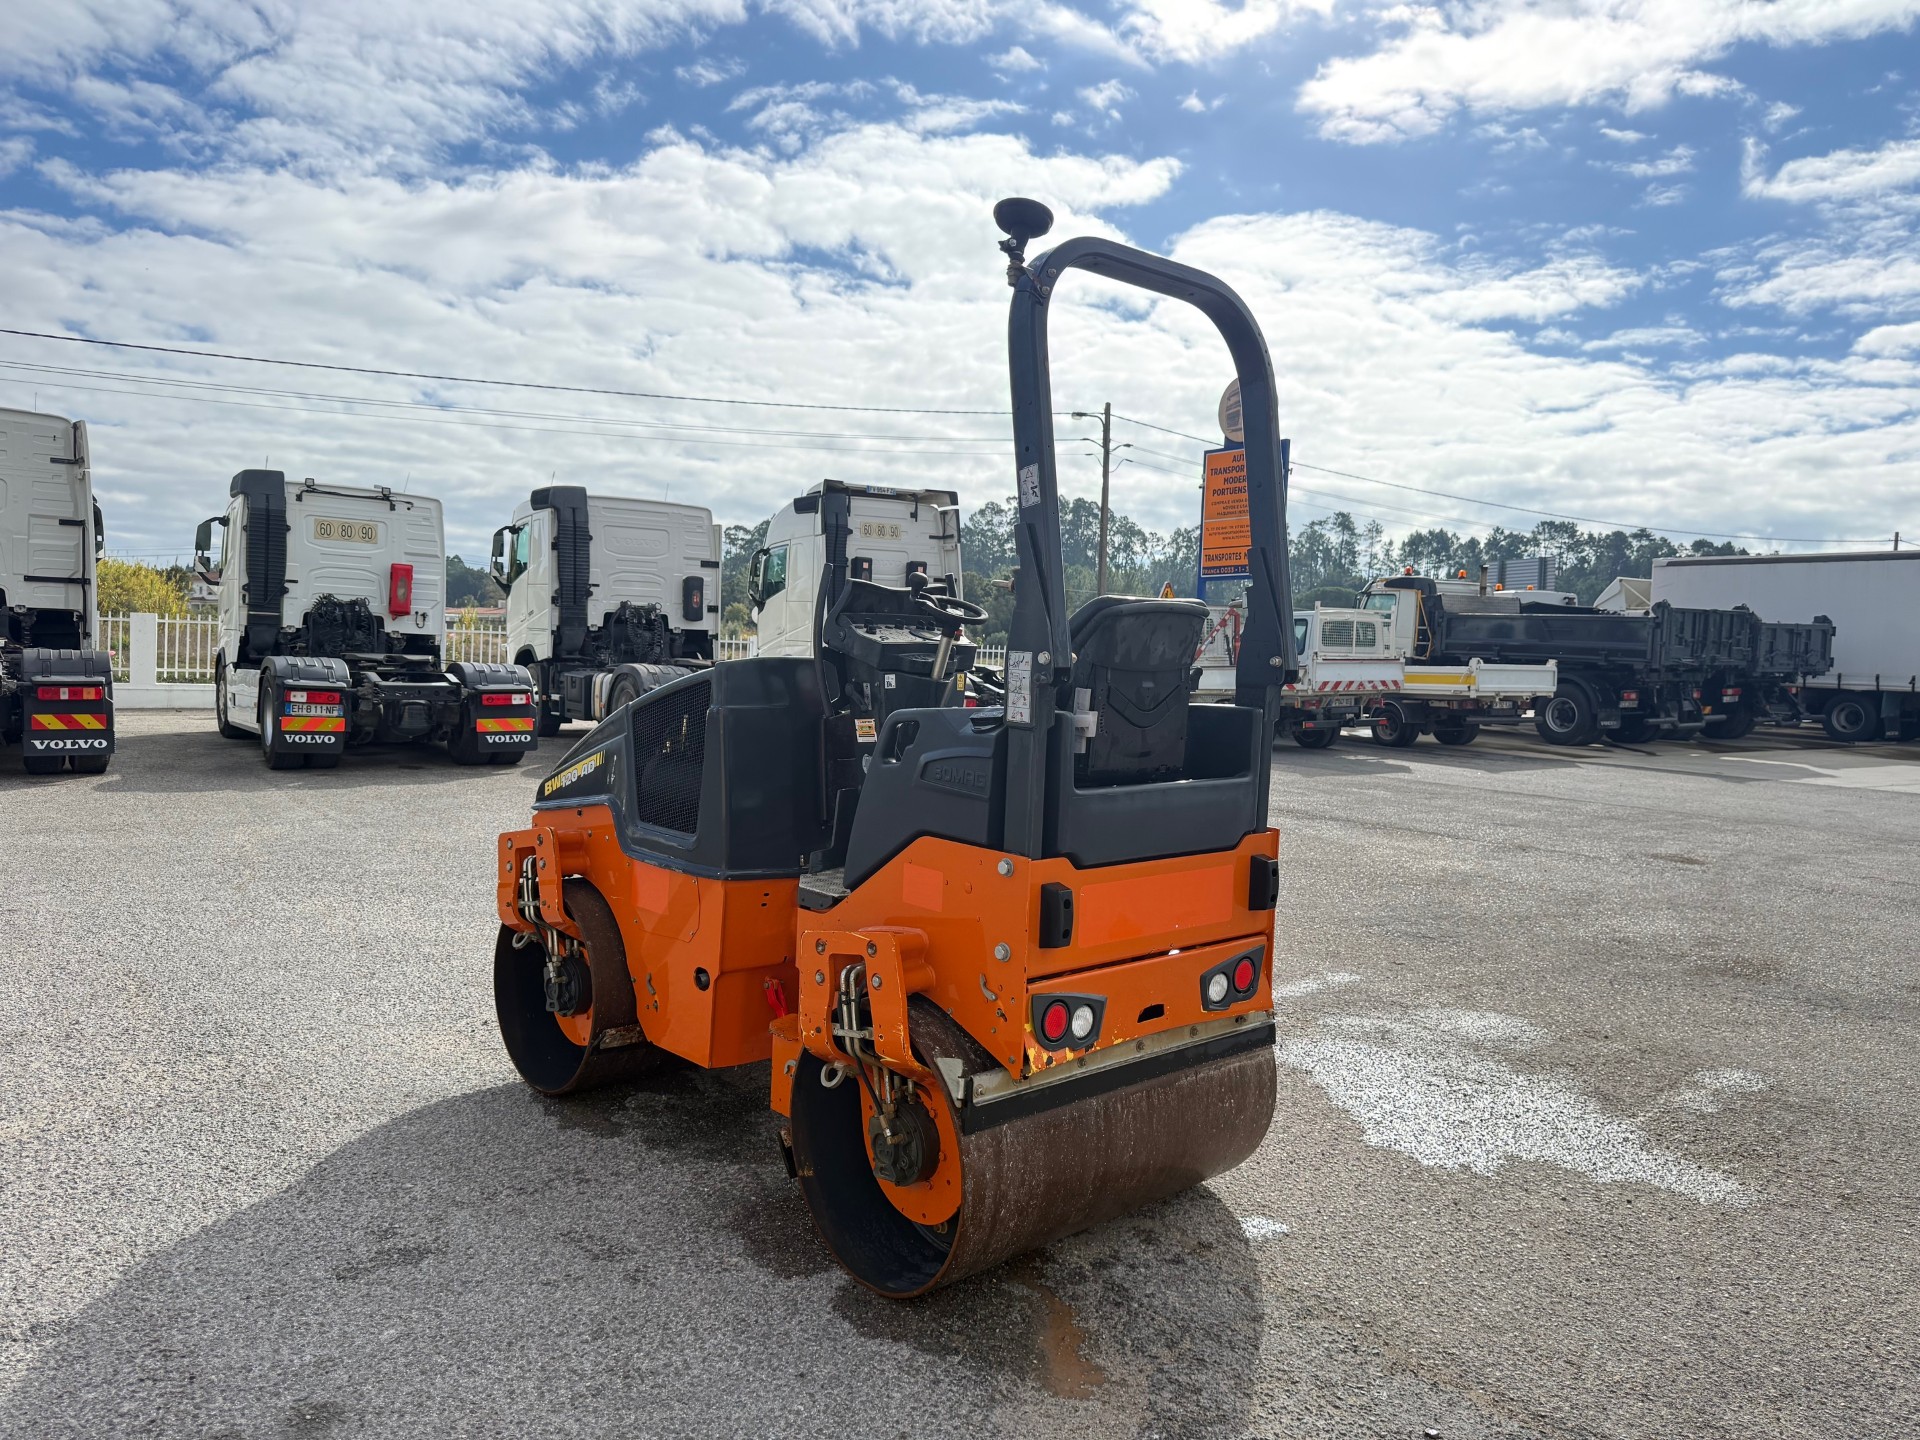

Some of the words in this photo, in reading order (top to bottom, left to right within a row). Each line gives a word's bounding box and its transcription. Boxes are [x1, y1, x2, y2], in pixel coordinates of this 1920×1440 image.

[1231, 453, 1245, 463] AUT
[1210, 465, 1245, 476] TRANSPOR
[1223, 475, 1247, 485] MODER
[1212, 486, 1247, 497] PORTUENS
[319, 522, 332, 536] 60
[340, 524, 353, 538] 80
[361, 526, 373, 540] 90
[863, 524, 872, 536] 60
[877, 525, 886, 537] 80
[890, 526, 899, 538] 90
[1205, 552, 1242, 562] TRANSPORTES
[284, 734, 336, 744] VOLVO
[485, 734, 532, 744] VOLVO
[30, 739, 108, 750] VOLVO
